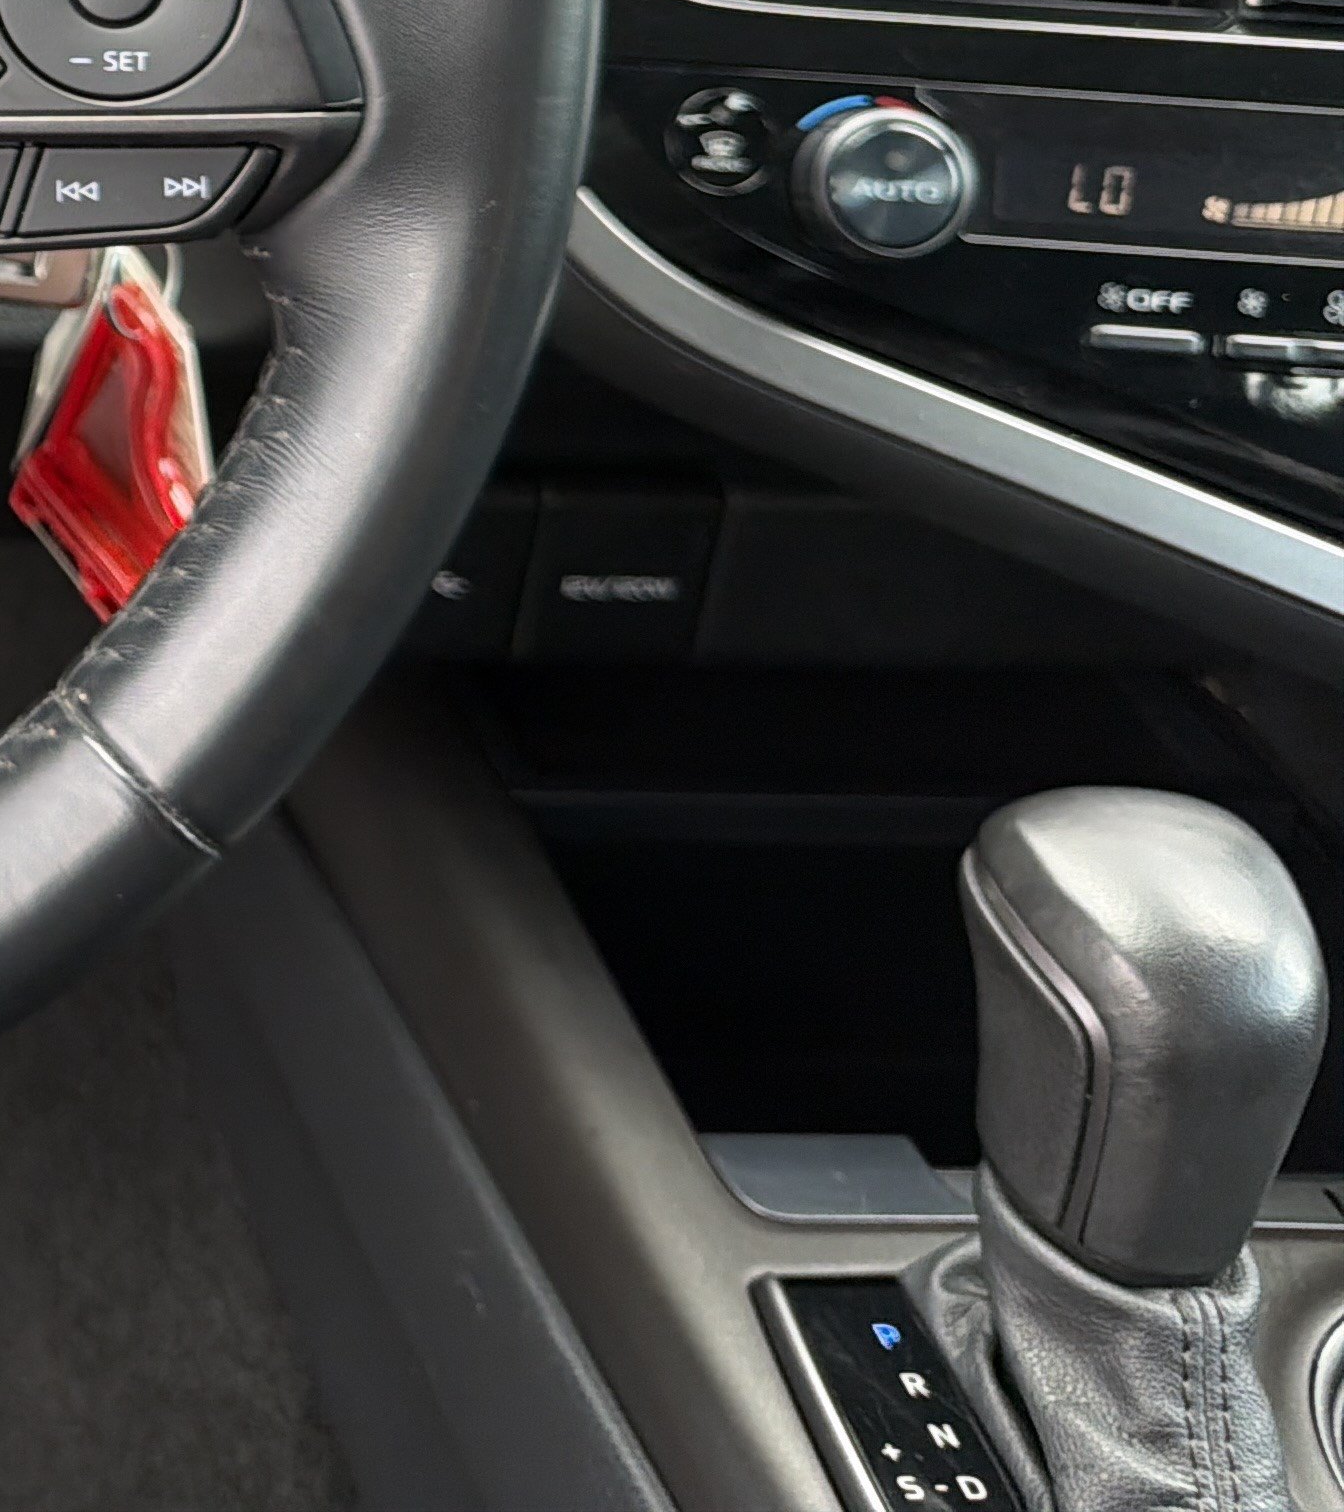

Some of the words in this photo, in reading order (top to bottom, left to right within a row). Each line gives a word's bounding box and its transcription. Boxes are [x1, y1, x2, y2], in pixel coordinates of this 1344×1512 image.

[852, 176, 946, 205] AUTO
[1067, 163, 1136, 217] LO
[1126, 288, 1195, 314] OFF
[871, 1323, 902, 1351] P
[898, 1372, 931, 1399] R
[926, 1423, 961, 1449] N
[896, 1475, 925, 1501] S
[955, 1475, 989, 1501] D
